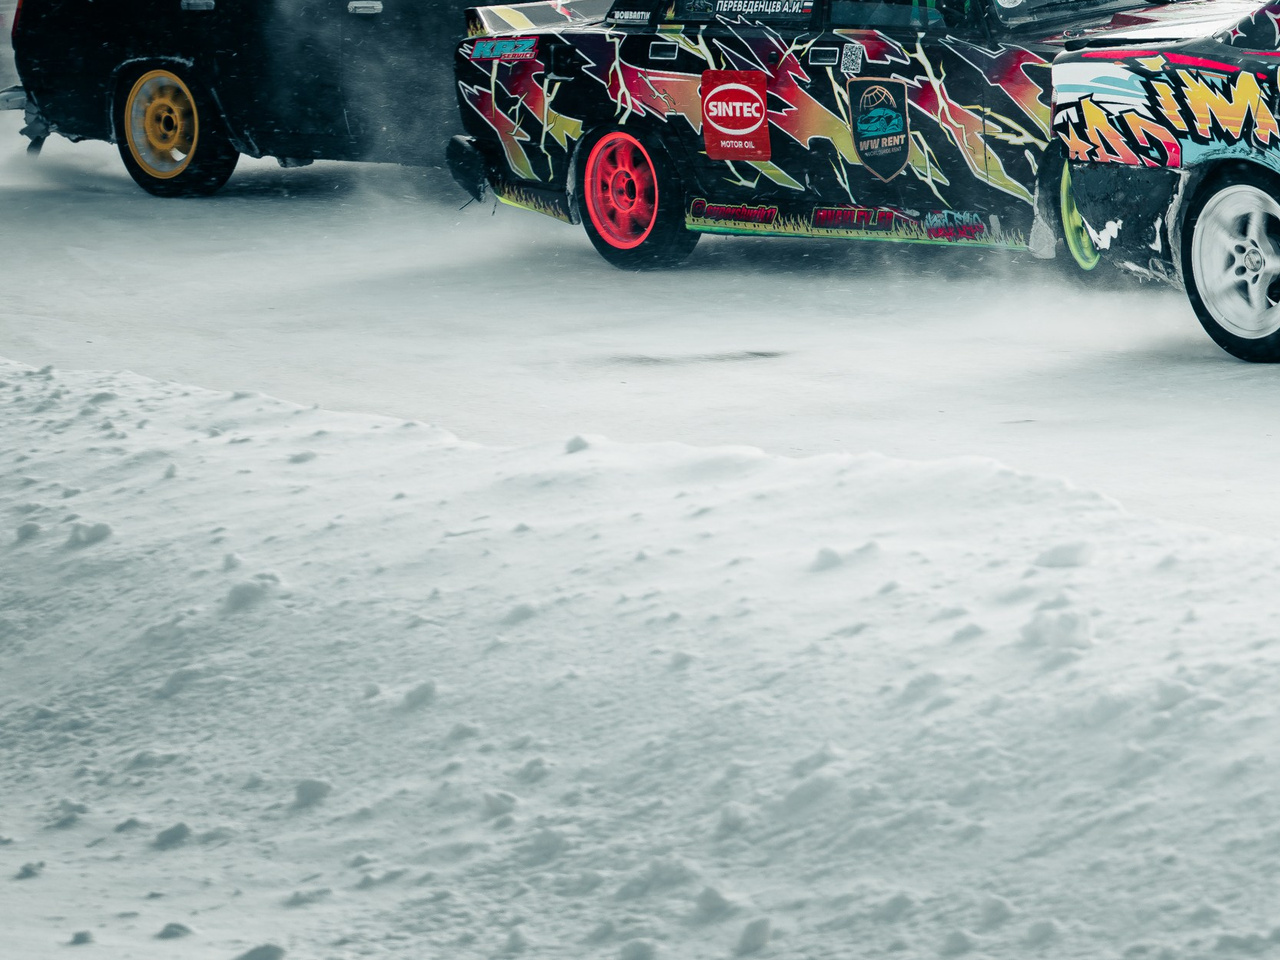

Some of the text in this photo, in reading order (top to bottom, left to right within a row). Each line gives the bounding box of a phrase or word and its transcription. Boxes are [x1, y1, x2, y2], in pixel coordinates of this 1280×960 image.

[716, 0, 781, 15] ПЕРЕВЕДЕНЦЕВ
[501, 52, 535, 60] SERVICE
[708, 101, 761, 119] SINTEC
[720, 140, 755, 149] MOTOR OIL
[860, 135, 906, 151] WW RENT
